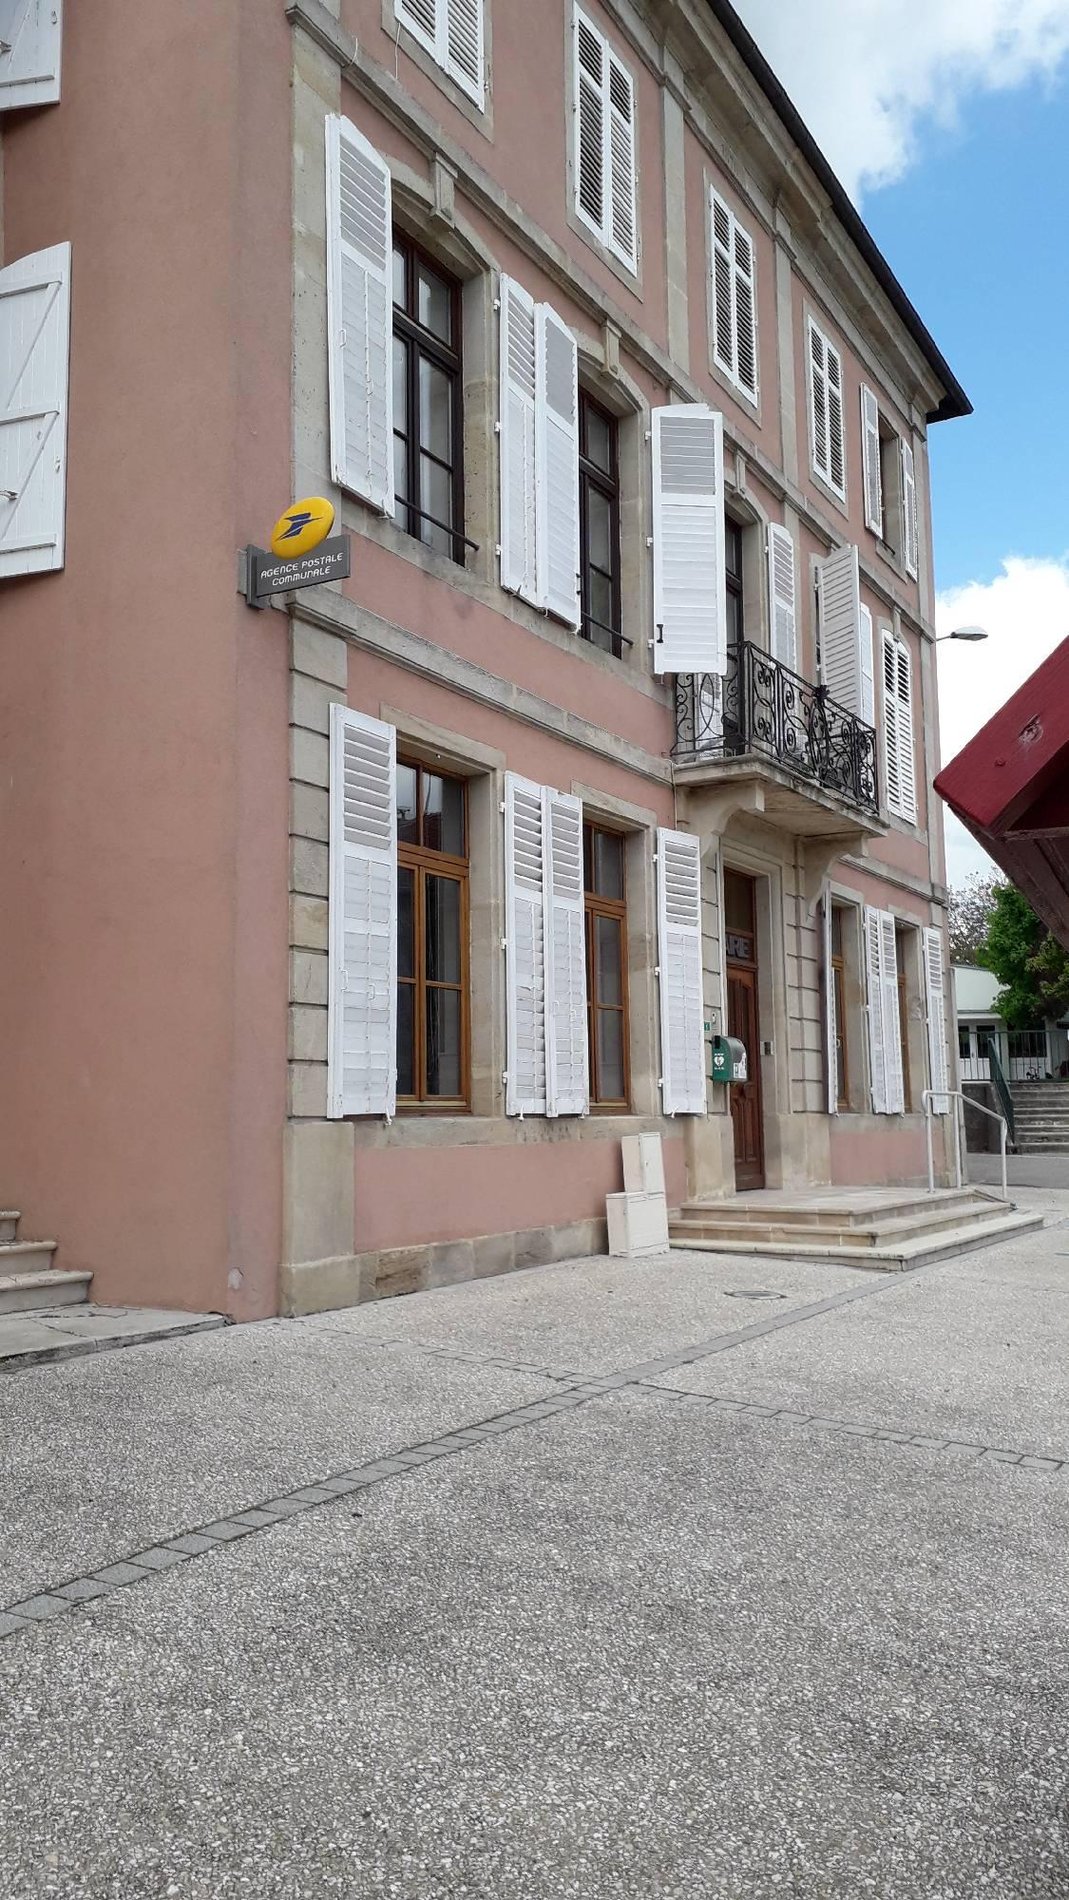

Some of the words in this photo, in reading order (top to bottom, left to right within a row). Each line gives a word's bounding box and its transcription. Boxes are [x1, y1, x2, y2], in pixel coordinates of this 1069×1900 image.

[260, 562, 299, 579] AGENCE
[301, 552, 344, 569] POSTALE
[272, 565, 331, 586] COMMUNALE
